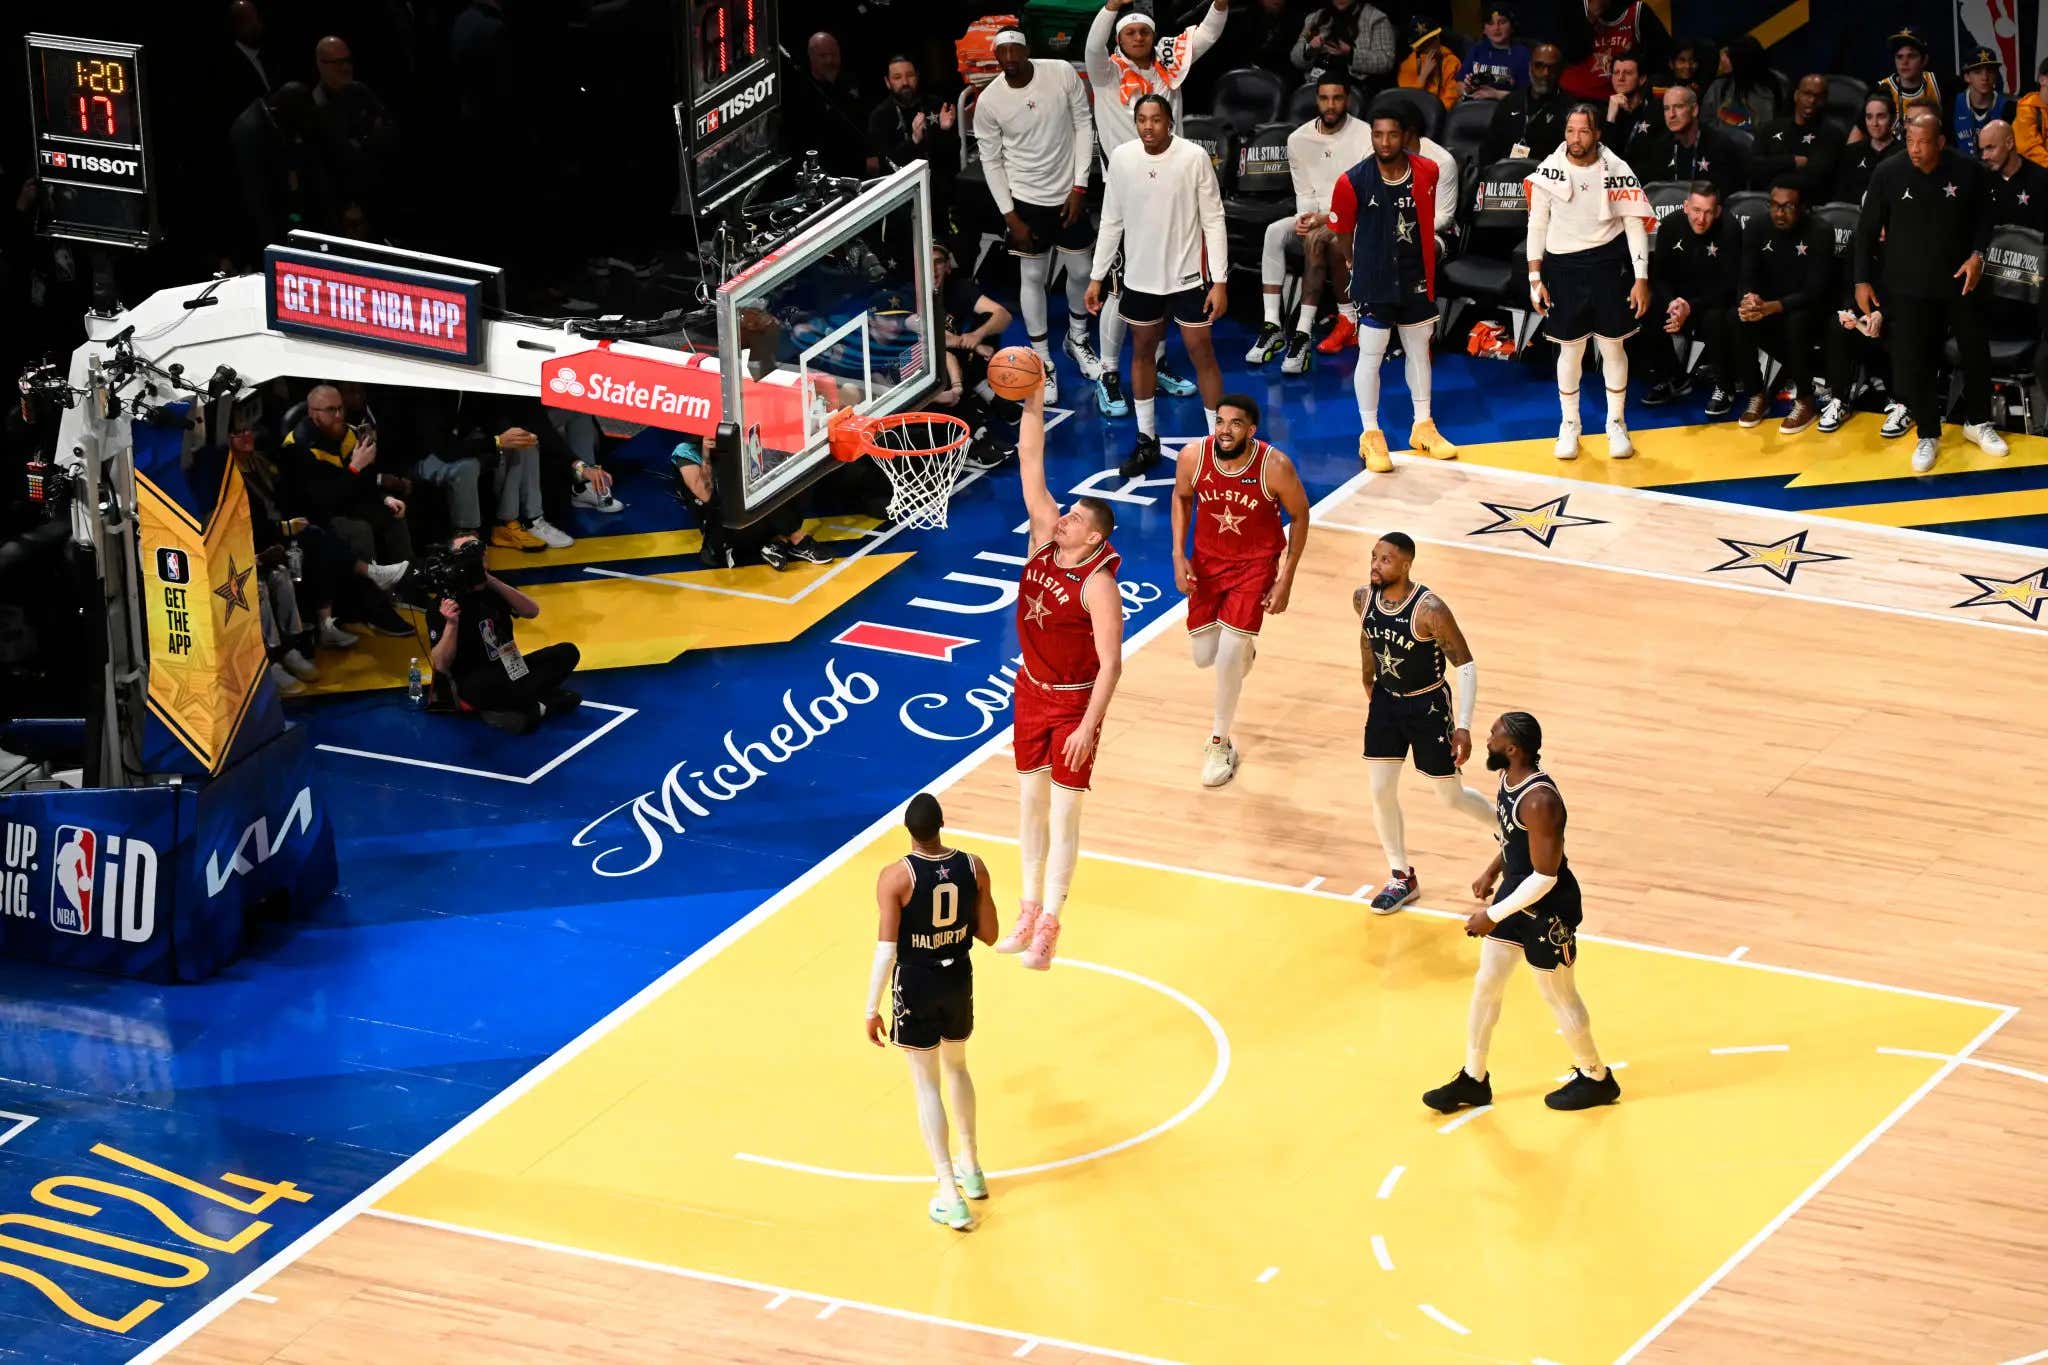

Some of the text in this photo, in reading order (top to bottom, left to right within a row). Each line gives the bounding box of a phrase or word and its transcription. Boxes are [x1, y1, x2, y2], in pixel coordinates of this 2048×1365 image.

[77, 61, 124, 93] 1:20
[80, 95, 114, 135] 17
[718, 72, 776, 124] TISSOT
[67, 153, 138, 176] TISSOT
[1501, 200, 1518, 208] INDY
[283, 273, 460, 339] GET THE NBA APP
[587, 373, 711, 420] State Farm
[1198, 489, 1259, 511] ALL-STAR
[164, 587, 187, 609] GET
[166, 610, 190, 633] THE
[168, 633, 192, 656] APP
[571, 657, 879, 877] Michelob
[5, 822, 39, 871] UP.
[0, 871, 36, 919] IG.
[932, 882, 959, 928] 0
[56, 907, 77, 927] NBA
[0, 1142, 315, 1334] 2024
